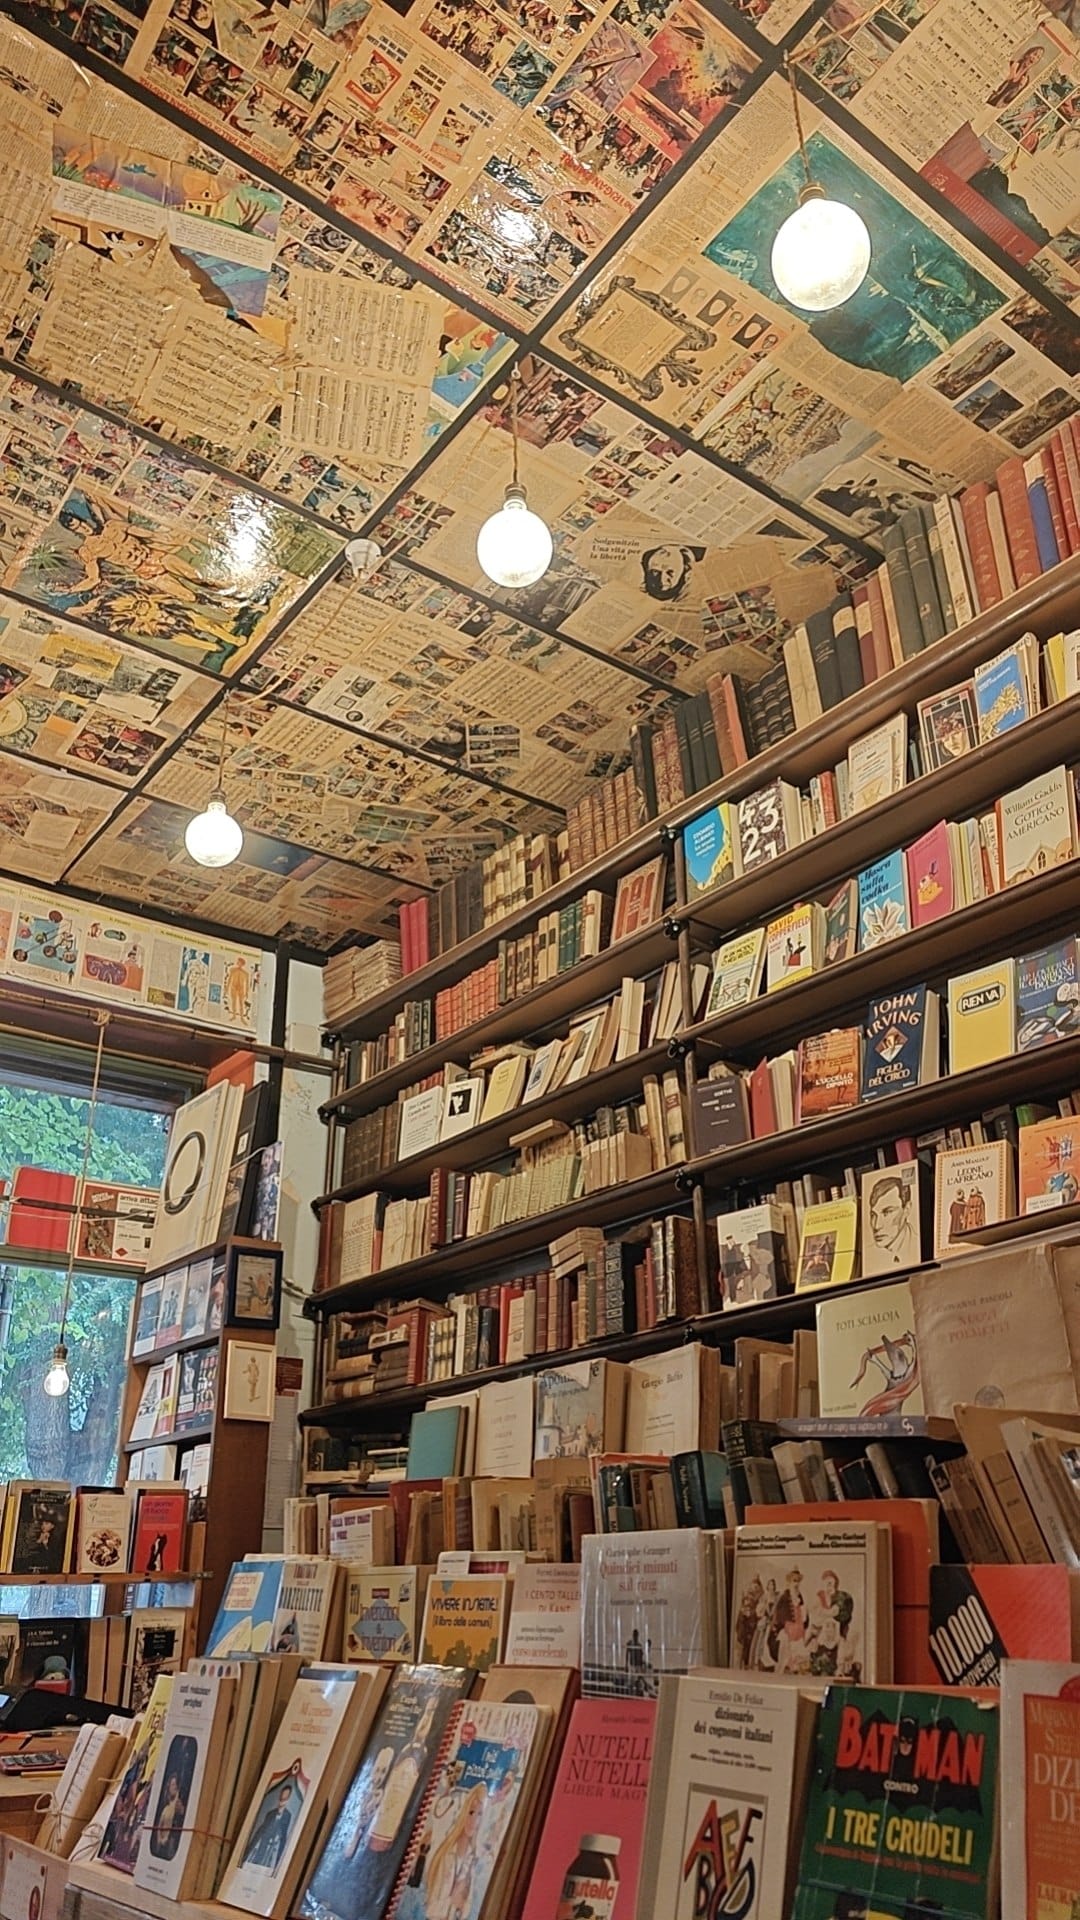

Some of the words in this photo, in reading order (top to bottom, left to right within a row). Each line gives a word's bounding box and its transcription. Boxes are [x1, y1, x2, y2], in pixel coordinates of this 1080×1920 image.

[759, 796, 779, 834] 3
[1004, 797, 1033, 816] William
[1014, 801, 1054, 826] GOTICO
[1007, 806, 1065, 842] AMERICANO
[742, 827, 761, 865] 2
[769, 915, 793, 934] DAVID
[873, 992, 918, 1019] JOHN
[962, 994, 985, 1011] RIEN
[985, 988, 1000, 1002] VA
[866, 1009, 922, 1039] IRVING
[868, 1074, 884, 1088] DEL
[884, 1068, 911, 1084] CIRCO
[876, 1062, 903, 1077] FIGLIO
[946, 1171, 994, 1186] L'AFRICANO
[957, 1165, 984, 1177] LEONE
[836, 1319, 855, 1332] TOTI
[856, 1310, 901, 1330] SCIALOJA
[929, 1594, 994, 1684] 10.000
[715, 1706, 755, 1723] dizionario
[694, 1720, 706, 1734] dei
[709, 1726, 742, 1739] cognomi
[745, 1727, 773, 1744] italiani
[572, 1734, 652, 1761] NUTELL
[567, 1759, 649, 1788] NUTELL
[1033, 1753, 1080, 1790] DIZI
[563, 1782, 604, 1797] LIBER
[883, 1779, 919, 1794] CONTRO
[826, 1806, 836, 1840] I
[843, 1808, 881, 1848] TRE
[885, 1815, 974, 1865] CRUDELI
[563, 1878, 617, 1900] nutella
